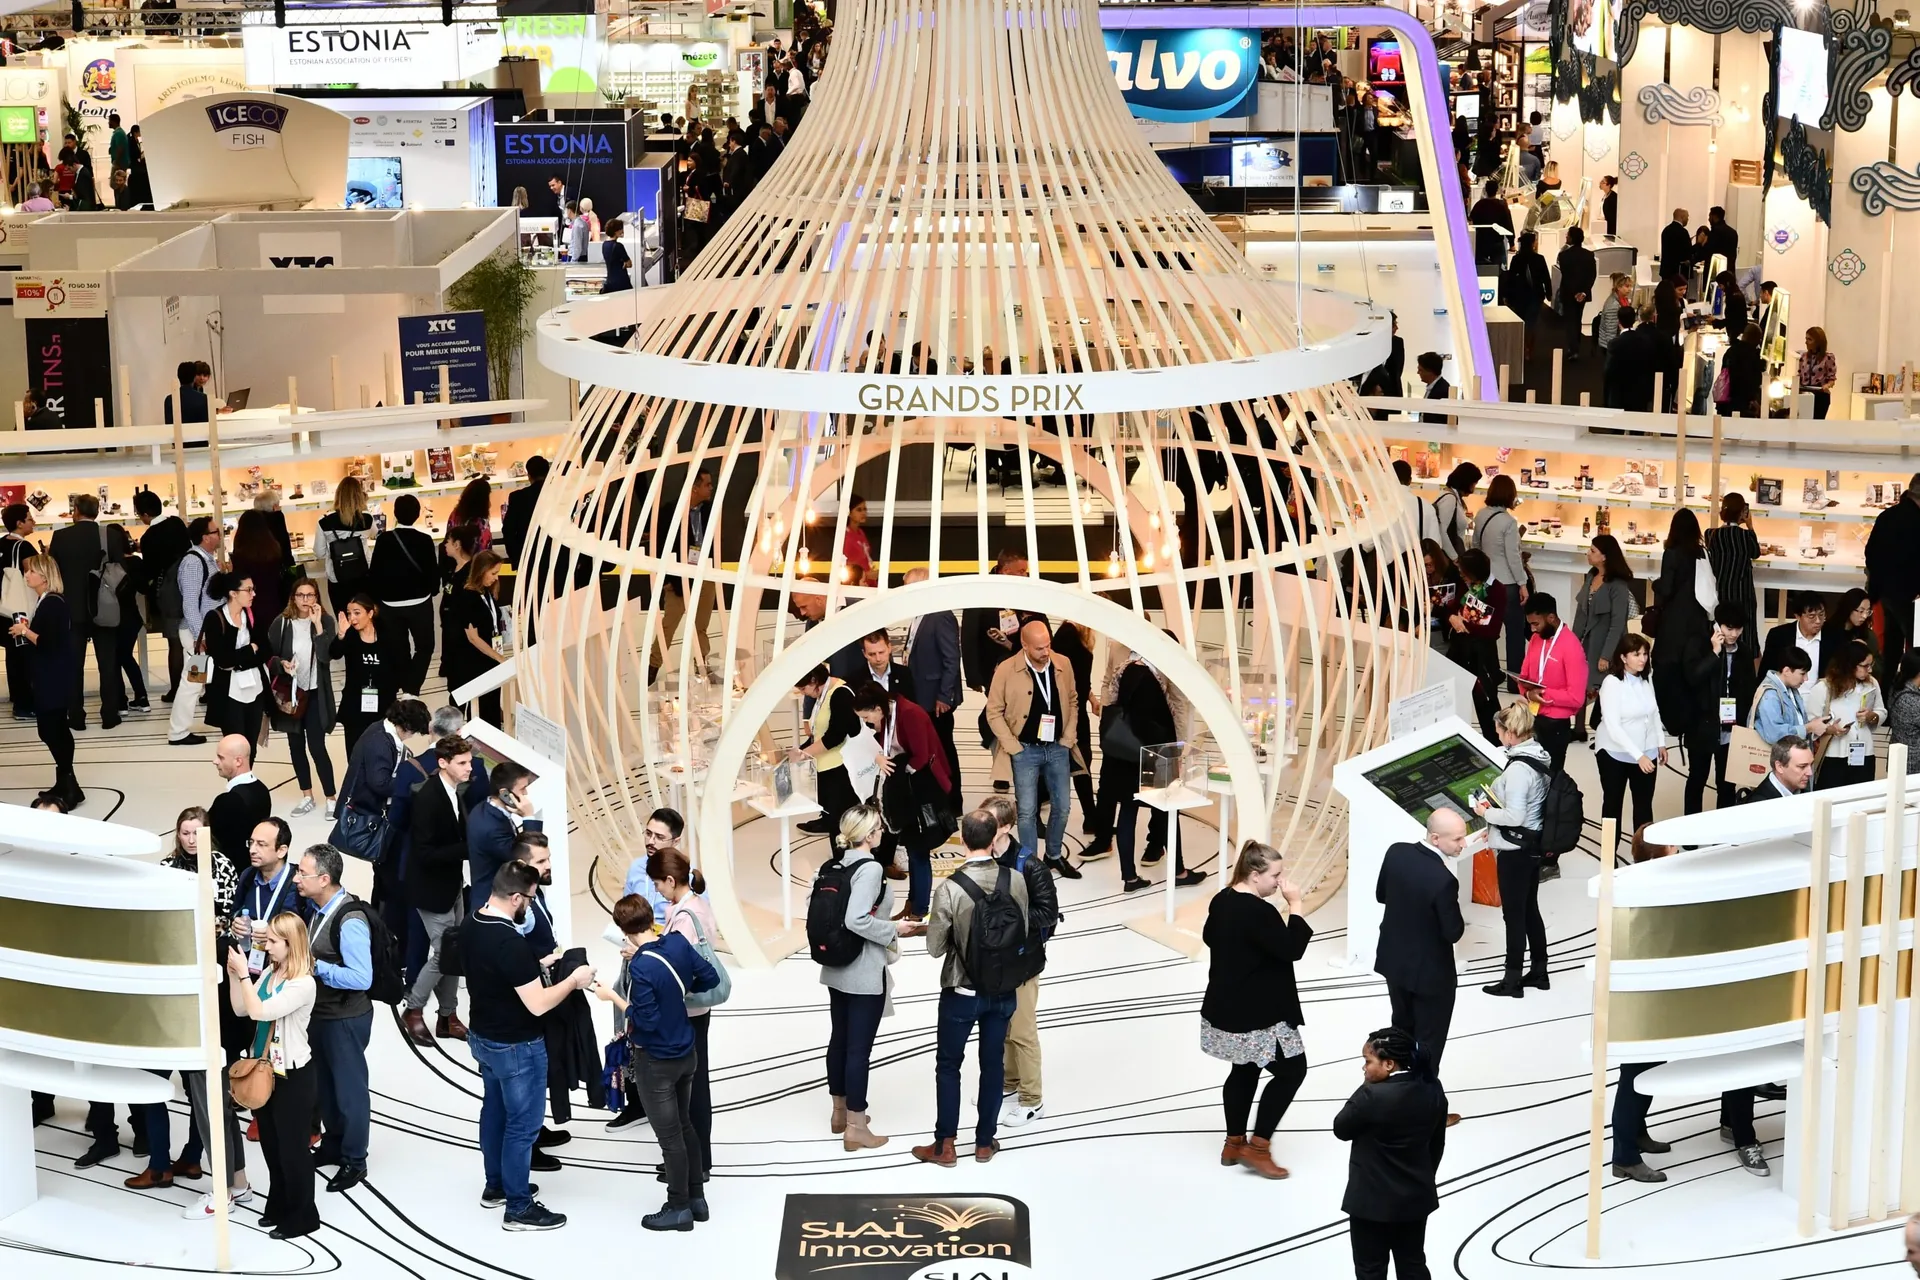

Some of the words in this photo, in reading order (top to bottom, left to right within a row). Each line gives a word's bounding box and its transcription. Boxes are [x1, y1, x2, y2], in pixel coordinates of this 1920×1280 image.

[502, 15, 586, 36] FRESH
[288, 28, 412, 53] ESTONIA
[289, 58, 324, 66] ESTONIAN
[325, 57, 371, 65] ASSOCIATION
[1108, 39, 1232, 92] alvo
[216, 104, 279, 126] ICECO
[232, 133, 265, 145] FISH
[505, 133, 612, 154] ESTONIA
[537, 157, 577, 165] ASSOCIATION
[427, 319, 456, 333] XTC
[426, 348, 449, 356] MIEUX
[450, 346, 482, 354] INNOVER
[431, 340, 470, 348] ACCOMPAGNER
[858, 383, 1000, 412] GRANDS
[1011, 383, 1085, 412] PRIX
[801, 1221, 924, 1239] SIAL
[799, 1239, 1012, 1258] Innovation
